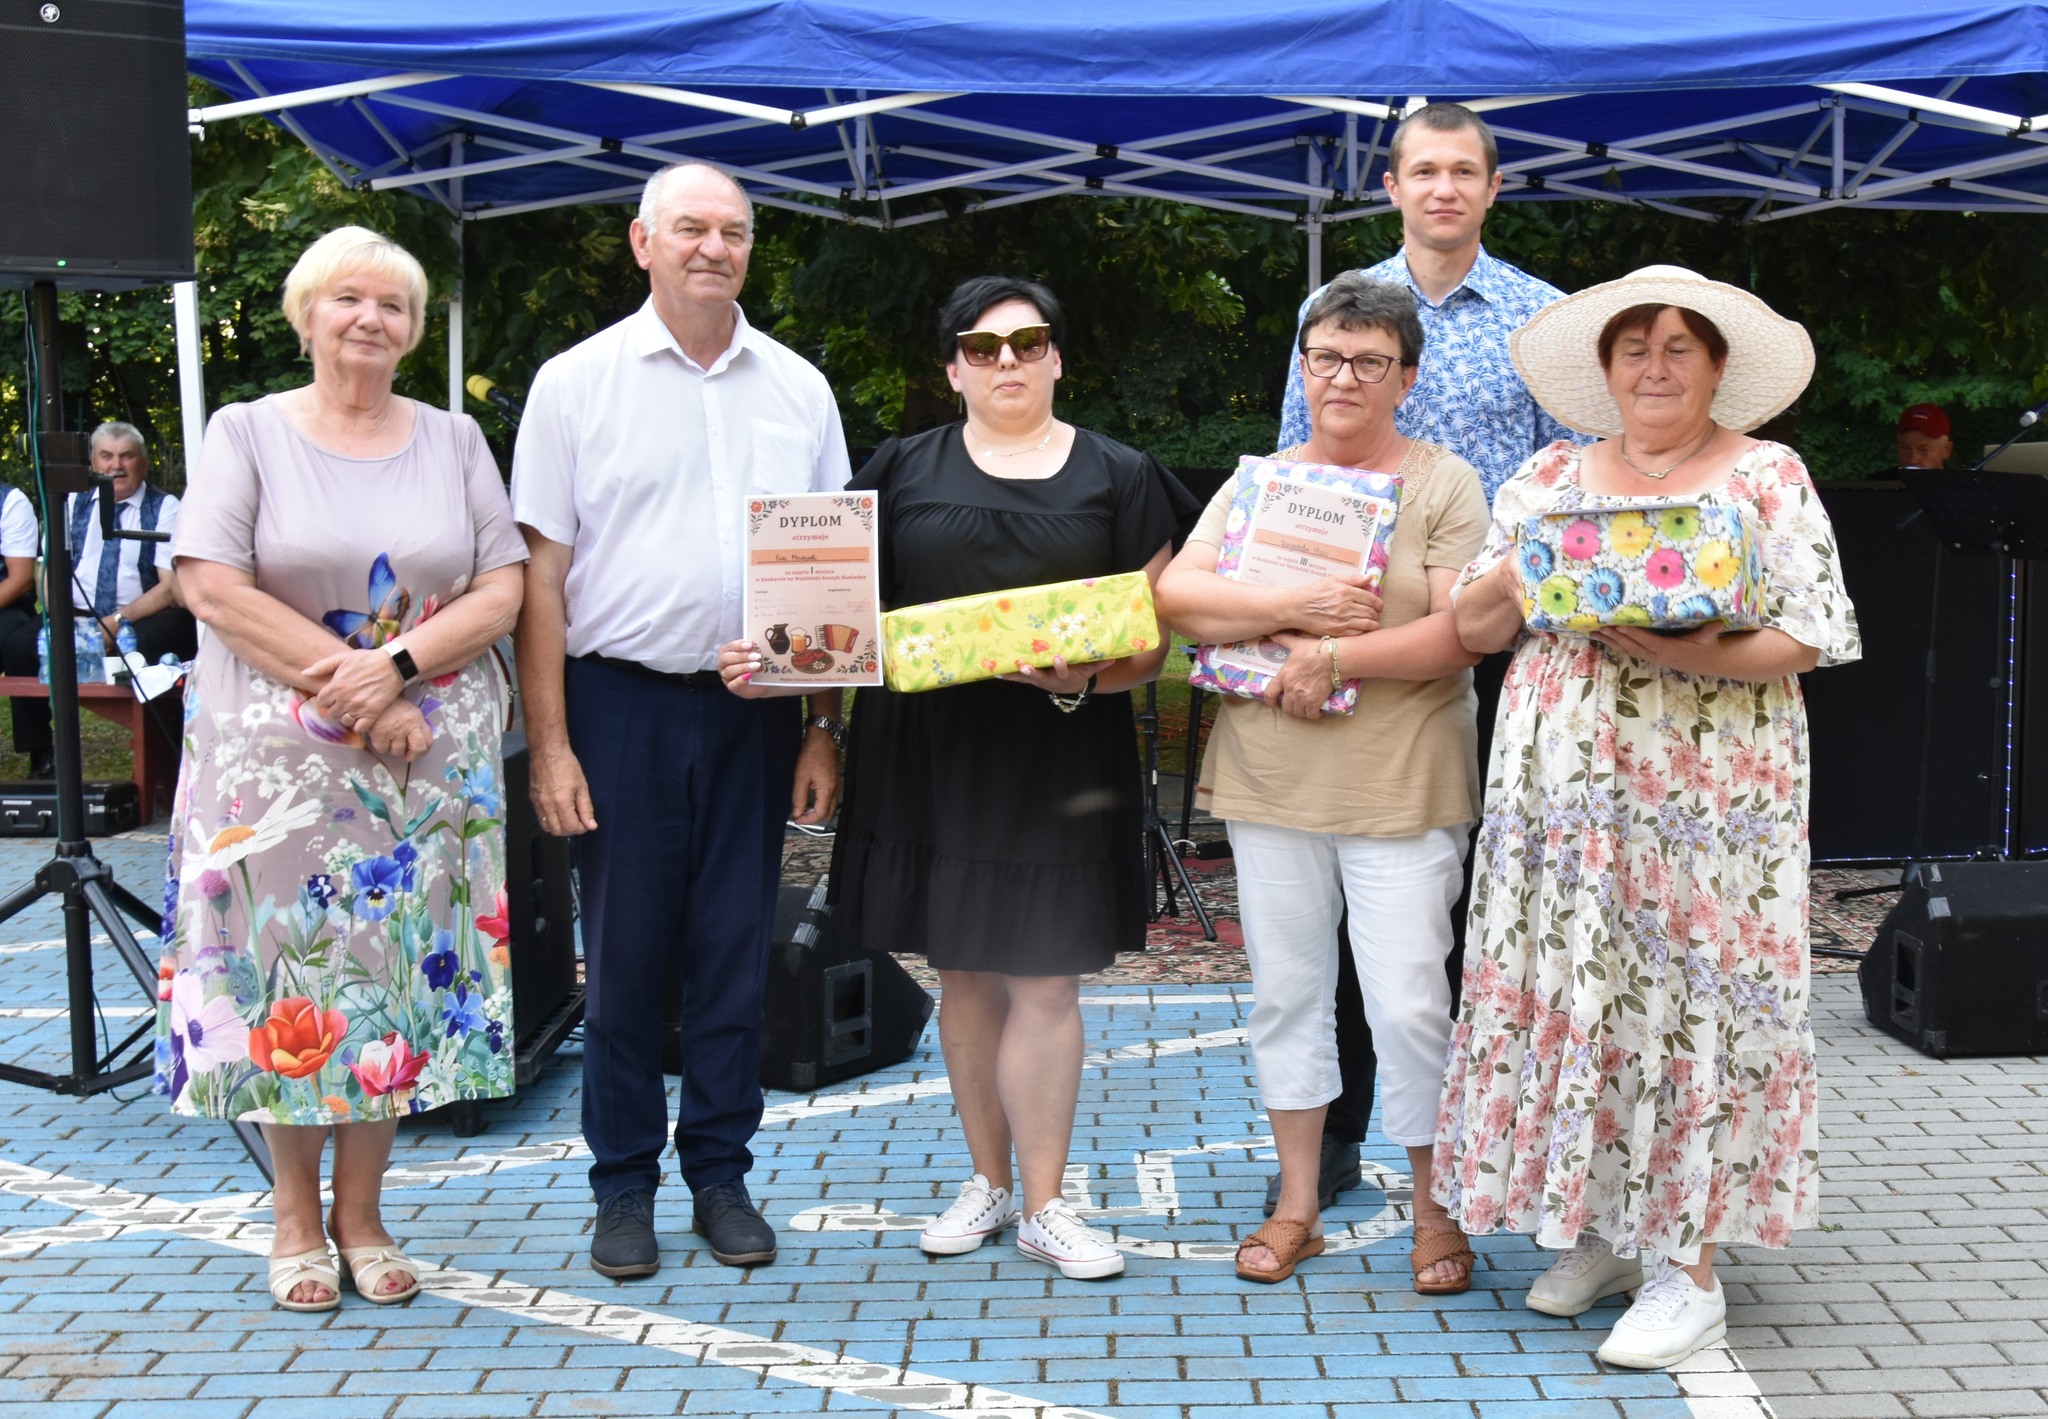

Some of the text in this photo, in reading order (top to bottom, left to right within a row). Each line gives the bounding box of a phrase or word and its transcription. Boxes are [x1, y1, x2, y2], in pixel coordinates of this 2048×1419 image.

[1287, 502, 1346, 525] DYPLOM
[779, 515, 842, 528] DYPLOM
[1295, 524, 1329, 536] otrzymuje
[792, 533, 829, 541] otrzymuje
[1300, 557, 1309, 566] III
